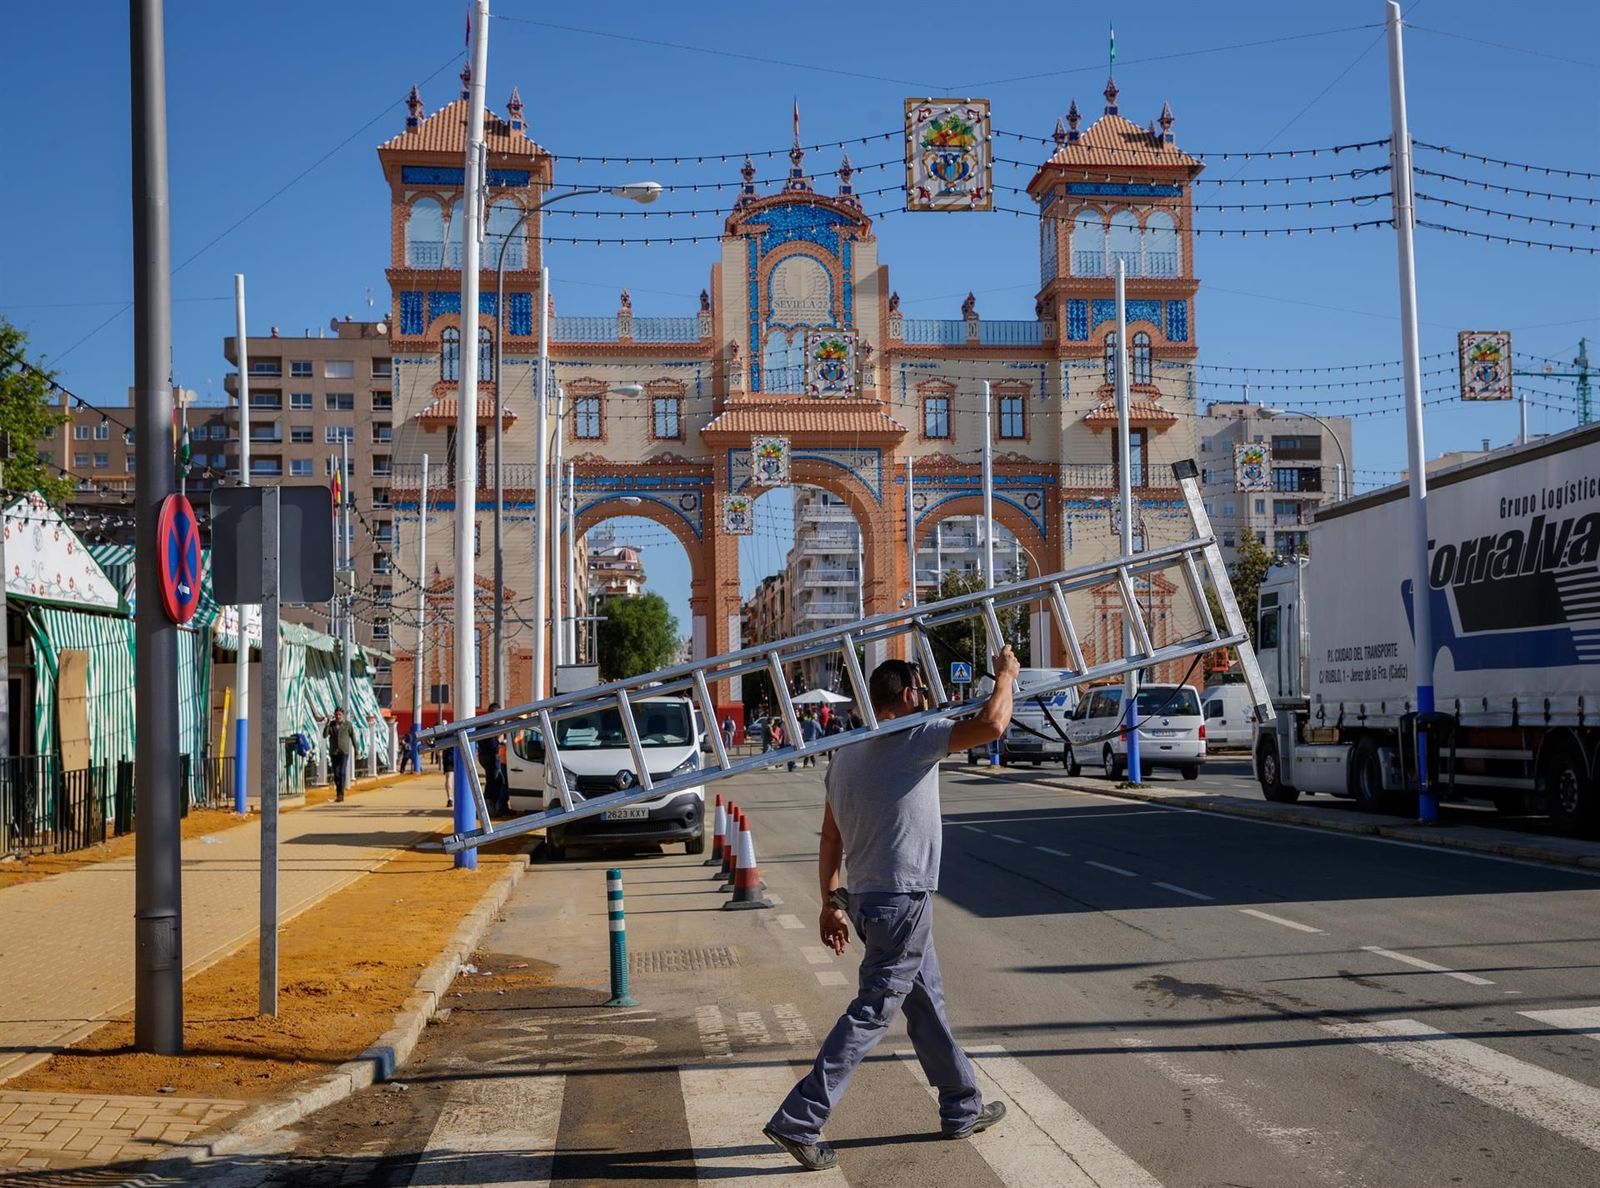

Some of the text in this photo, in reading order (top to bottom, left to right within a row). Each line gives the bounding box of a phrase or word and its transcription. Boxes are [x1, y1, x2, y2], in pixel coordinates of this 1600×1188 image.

[774, 300, 816, 309] SEVILLA
[853, 456, 874, 467] DO
[1498, 493, 1537, 519] Grupo
[1335, 648, 1353, 662] CIUDAD
[1353, 646, 1364, 661] DEL
[1364, 643, 1397, 659] TRANSPORTE
[1350, 667, 1364, 682] Jerez
[1364, 667, 1371, 681] de
[1371, 667, 1378, 681] la
[607, 809, 646, 819] 2623 KXY
